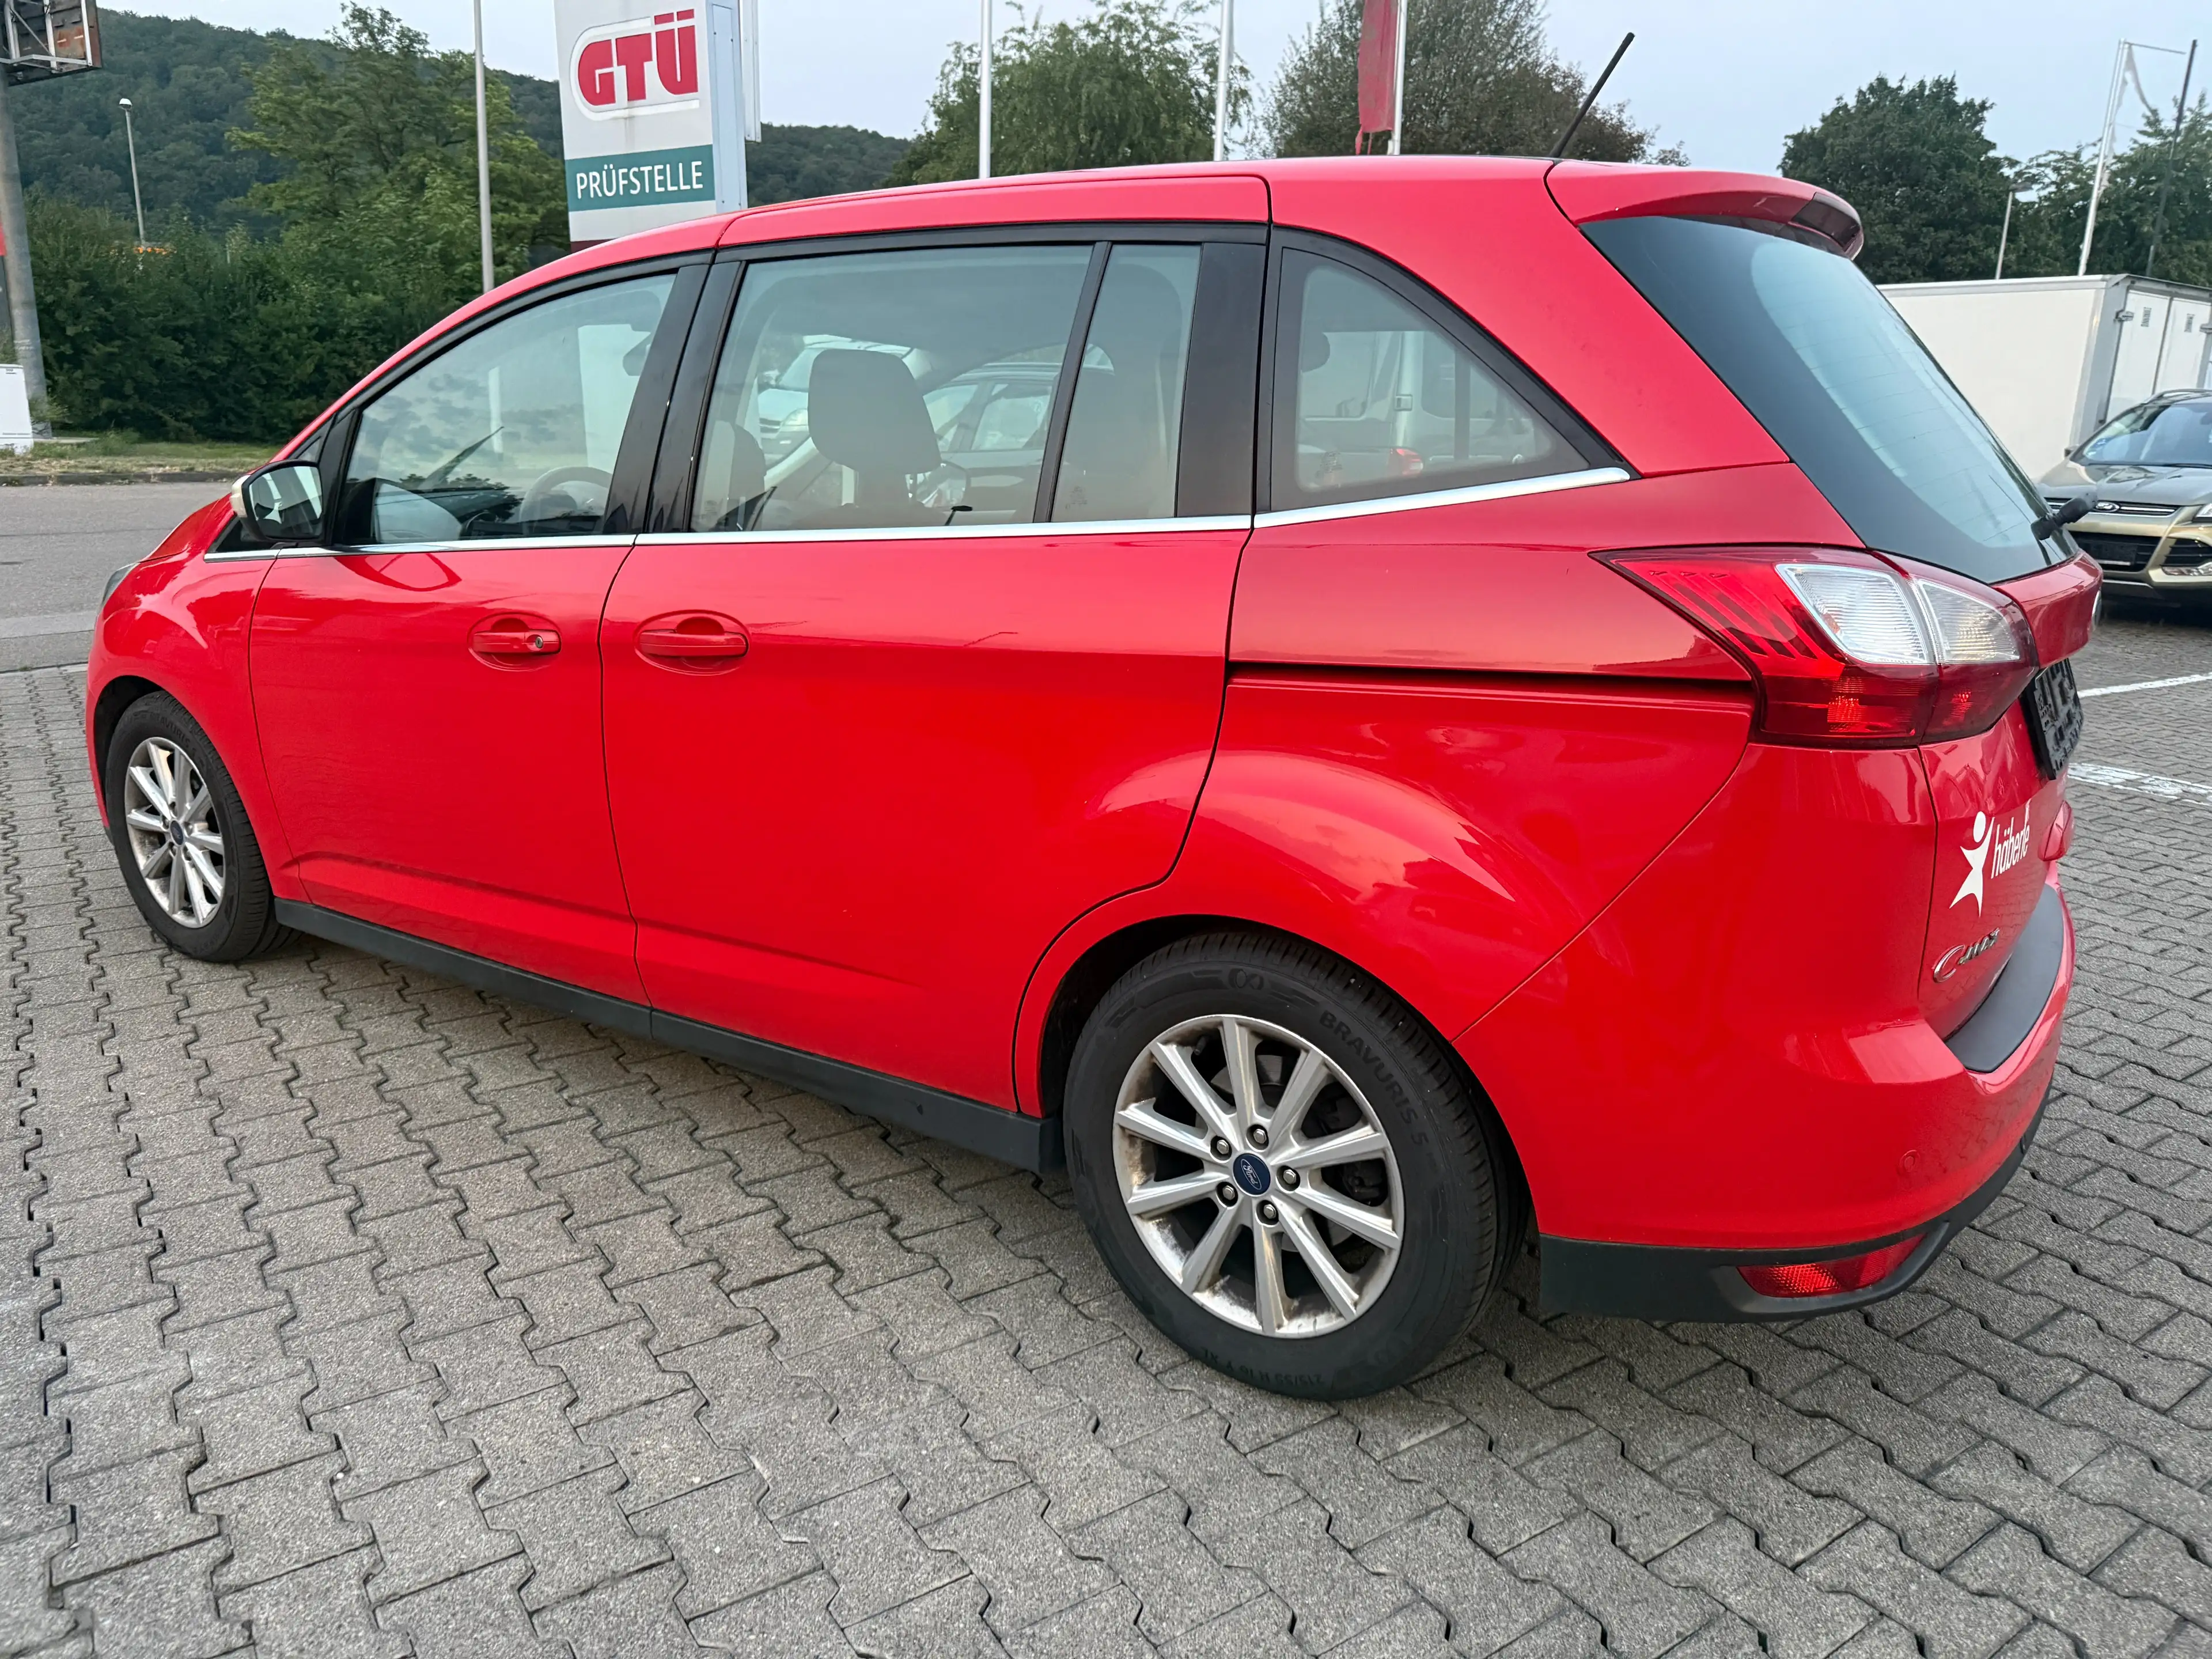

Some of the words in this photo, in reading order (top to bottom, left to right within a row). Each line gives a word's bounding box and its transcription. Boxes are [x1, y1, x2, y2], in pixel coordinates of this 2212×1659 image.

[578, 9, 699, 106] GTÜ
[577, 161, 703, 199] PRÜFSTELLE
[1991, 817, 2030, 879] häberle
[1319, 1010, 1419, 1124] BRAVURIS
[1243, 1165, 1259, 1185] Ford
